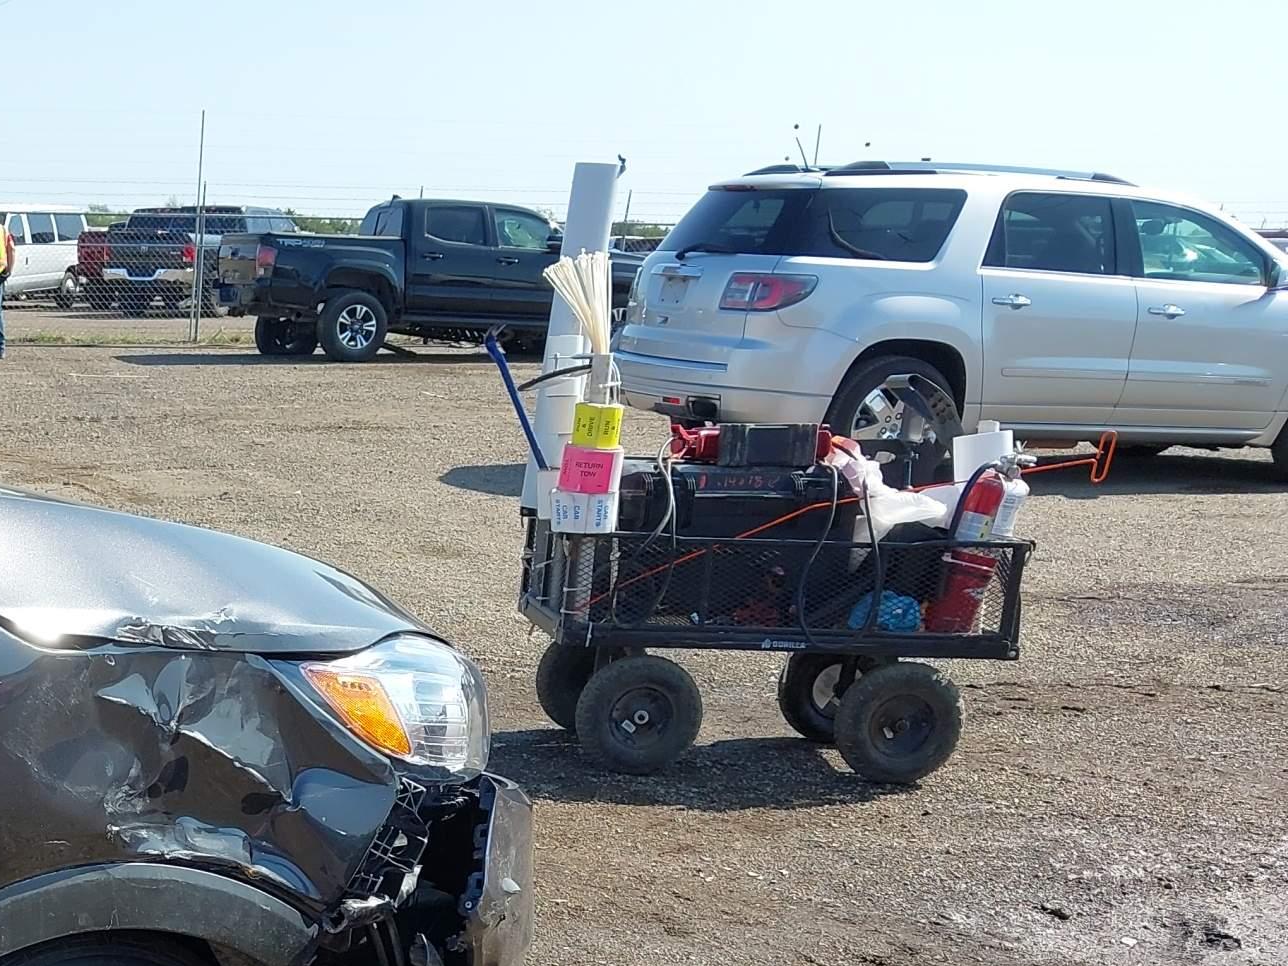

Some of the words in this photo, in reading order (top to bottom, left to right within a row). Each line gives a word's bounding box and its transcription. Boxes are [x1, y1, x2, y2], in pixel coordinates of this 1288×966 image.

[587, 416, 596, 437] DRIVE
[575, 461, 604, 470] RETURN
[579, 470, 597, 478] TOW
